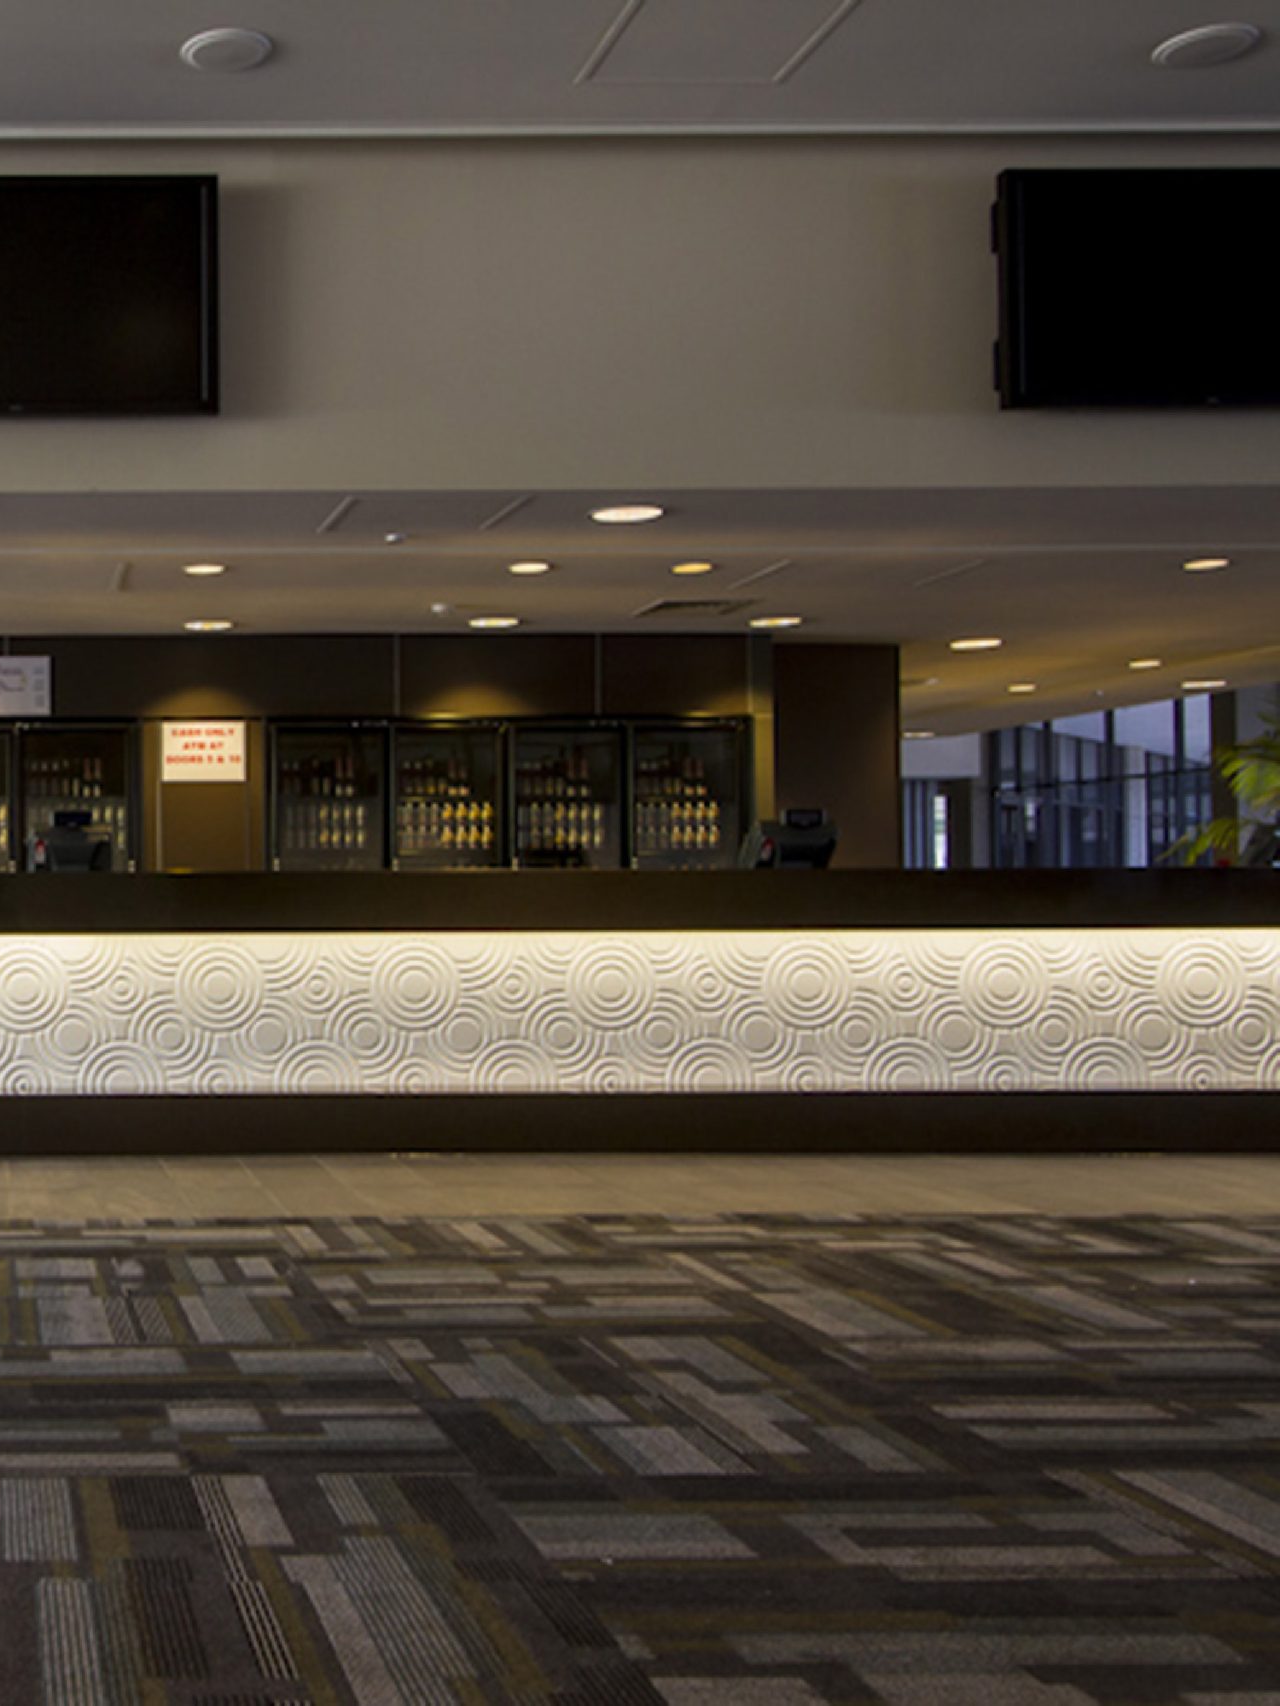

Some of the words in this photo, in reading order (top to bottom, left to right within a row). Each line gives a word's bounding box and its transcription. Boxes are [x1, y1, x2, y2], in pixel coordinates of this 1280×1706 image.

[205, 728, 235, 737] ONLY
[183, 741, 206, 750] ATM
[210, 741, 225, 750] AT
[166, 755, 203, 764] DOORS
